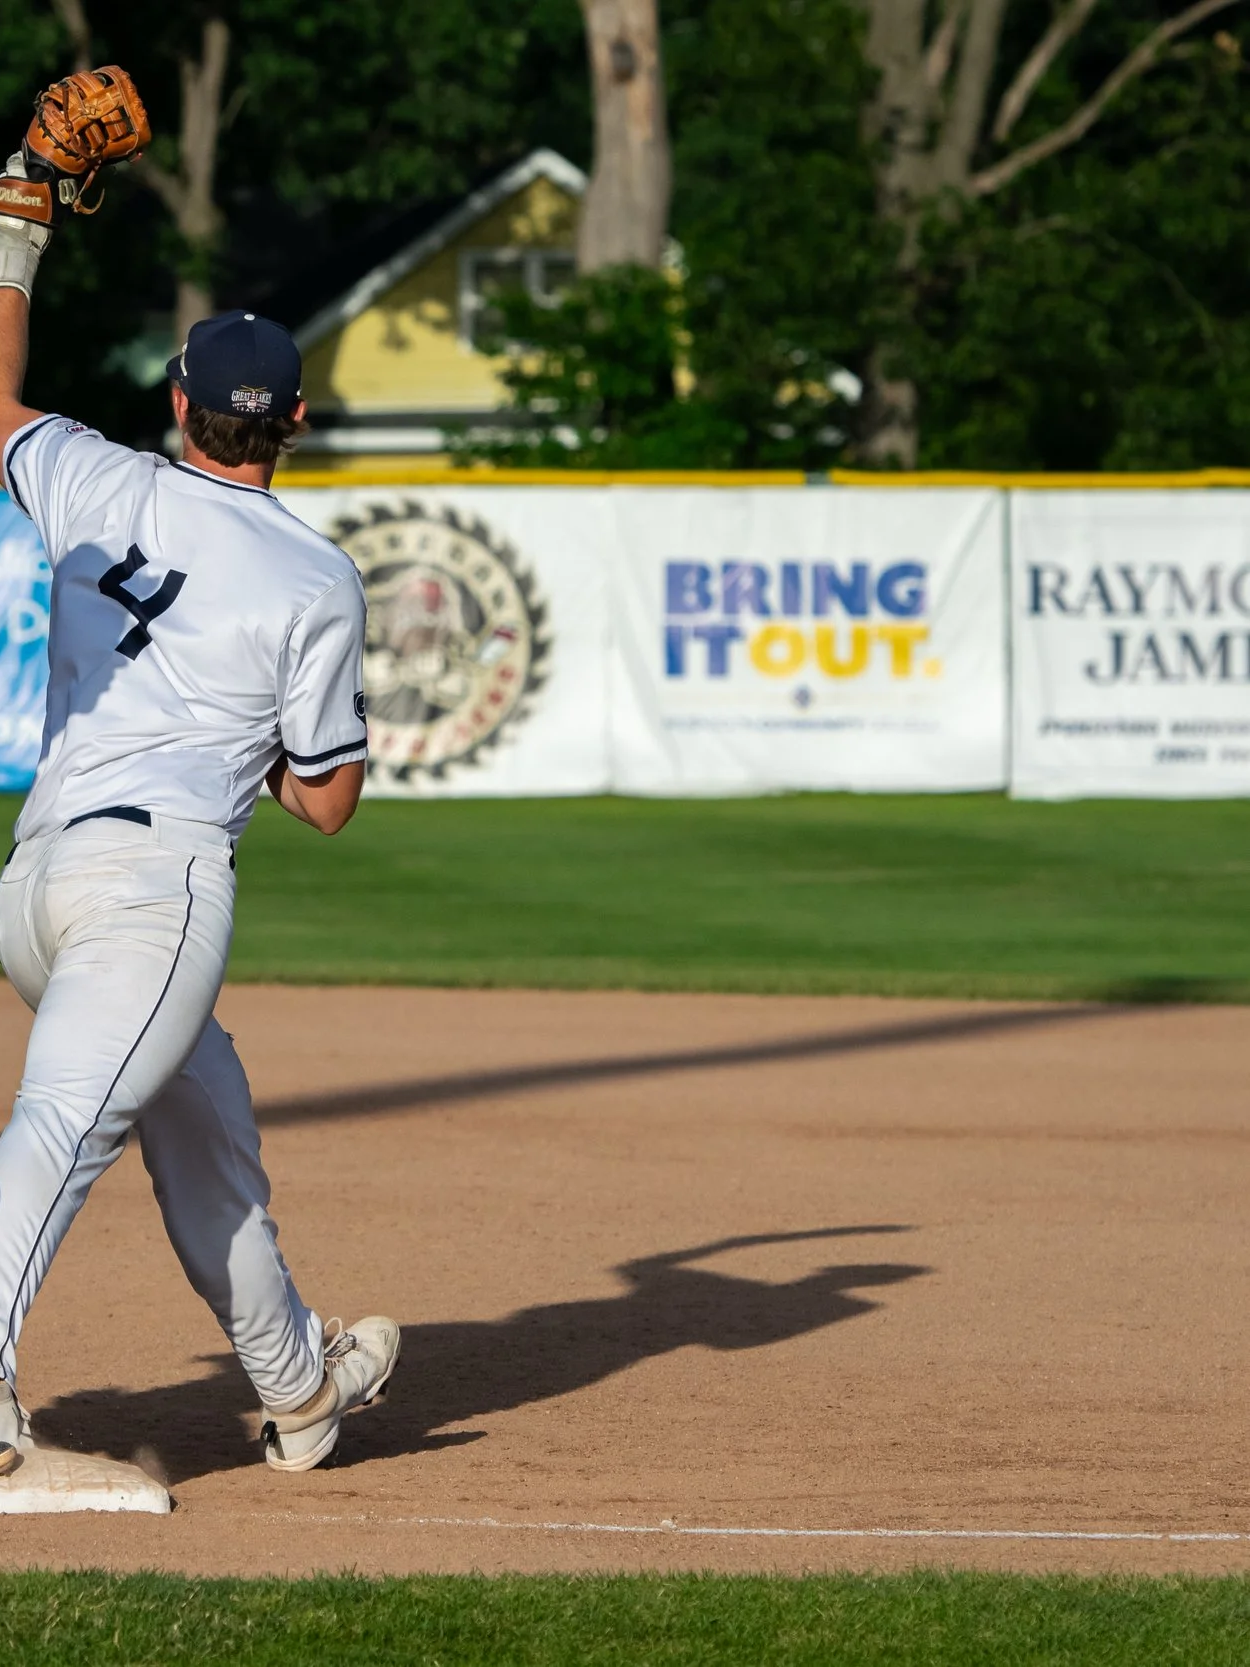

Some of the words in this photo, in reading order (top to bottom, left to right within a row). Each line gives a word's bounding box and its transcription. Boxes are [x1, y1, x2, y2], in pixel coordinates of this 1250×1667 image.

[231, 390, 251, 402] GREAT
[255, 392, 272, 405] LAKES
[97, 542, 188, 661] 4
[663, 560, 928, 617] BRING
[663, 623, 743, 678] IT
[1082, 628, 1250, 687] JAM
